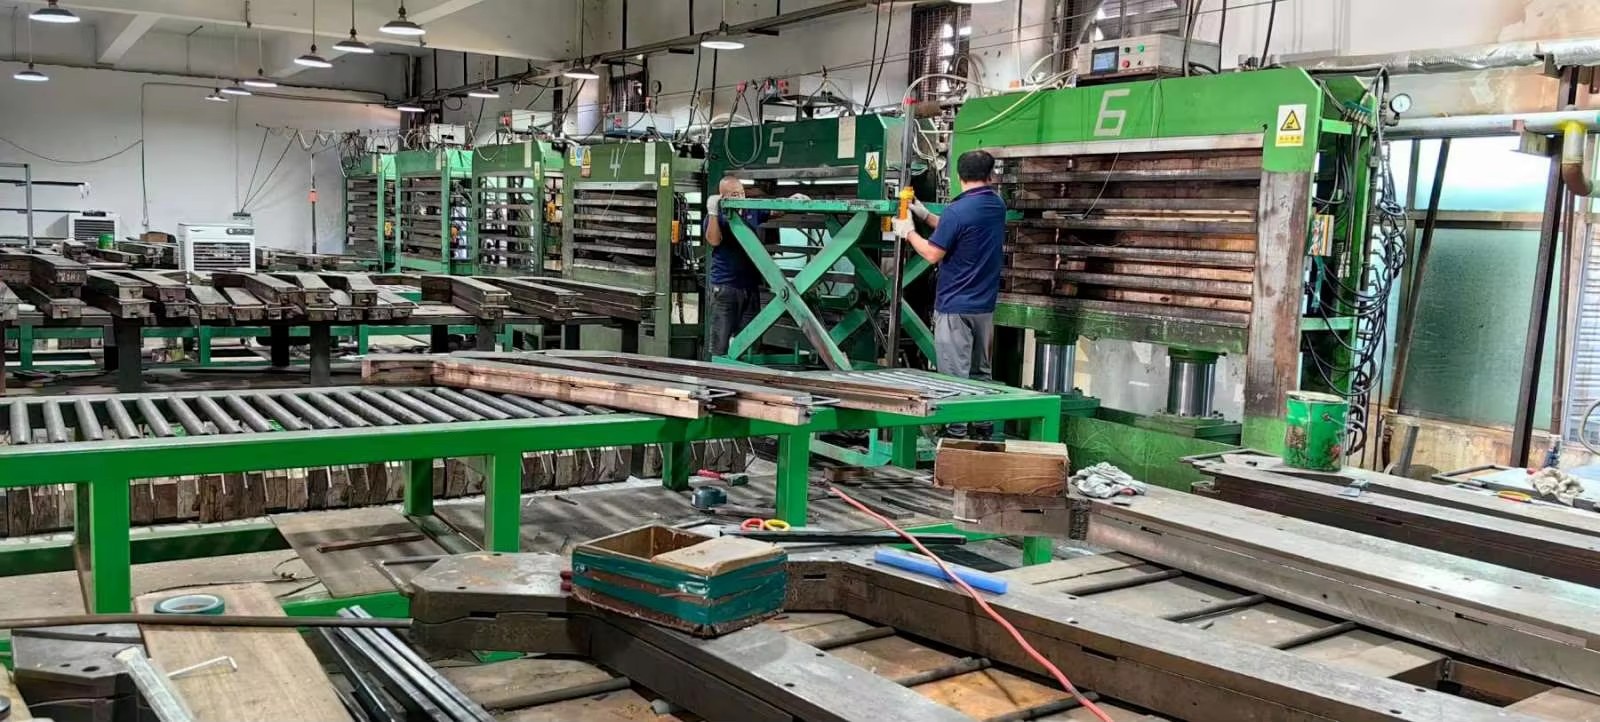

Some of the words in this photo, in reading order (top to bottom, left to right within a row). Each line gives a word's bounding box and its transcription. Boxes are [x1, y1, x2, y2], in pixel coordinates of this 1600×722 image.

[1093, 88, 1130, 136] 6
[610, 147, 621, 178] 4
[766, 127, 785, 164] 5
